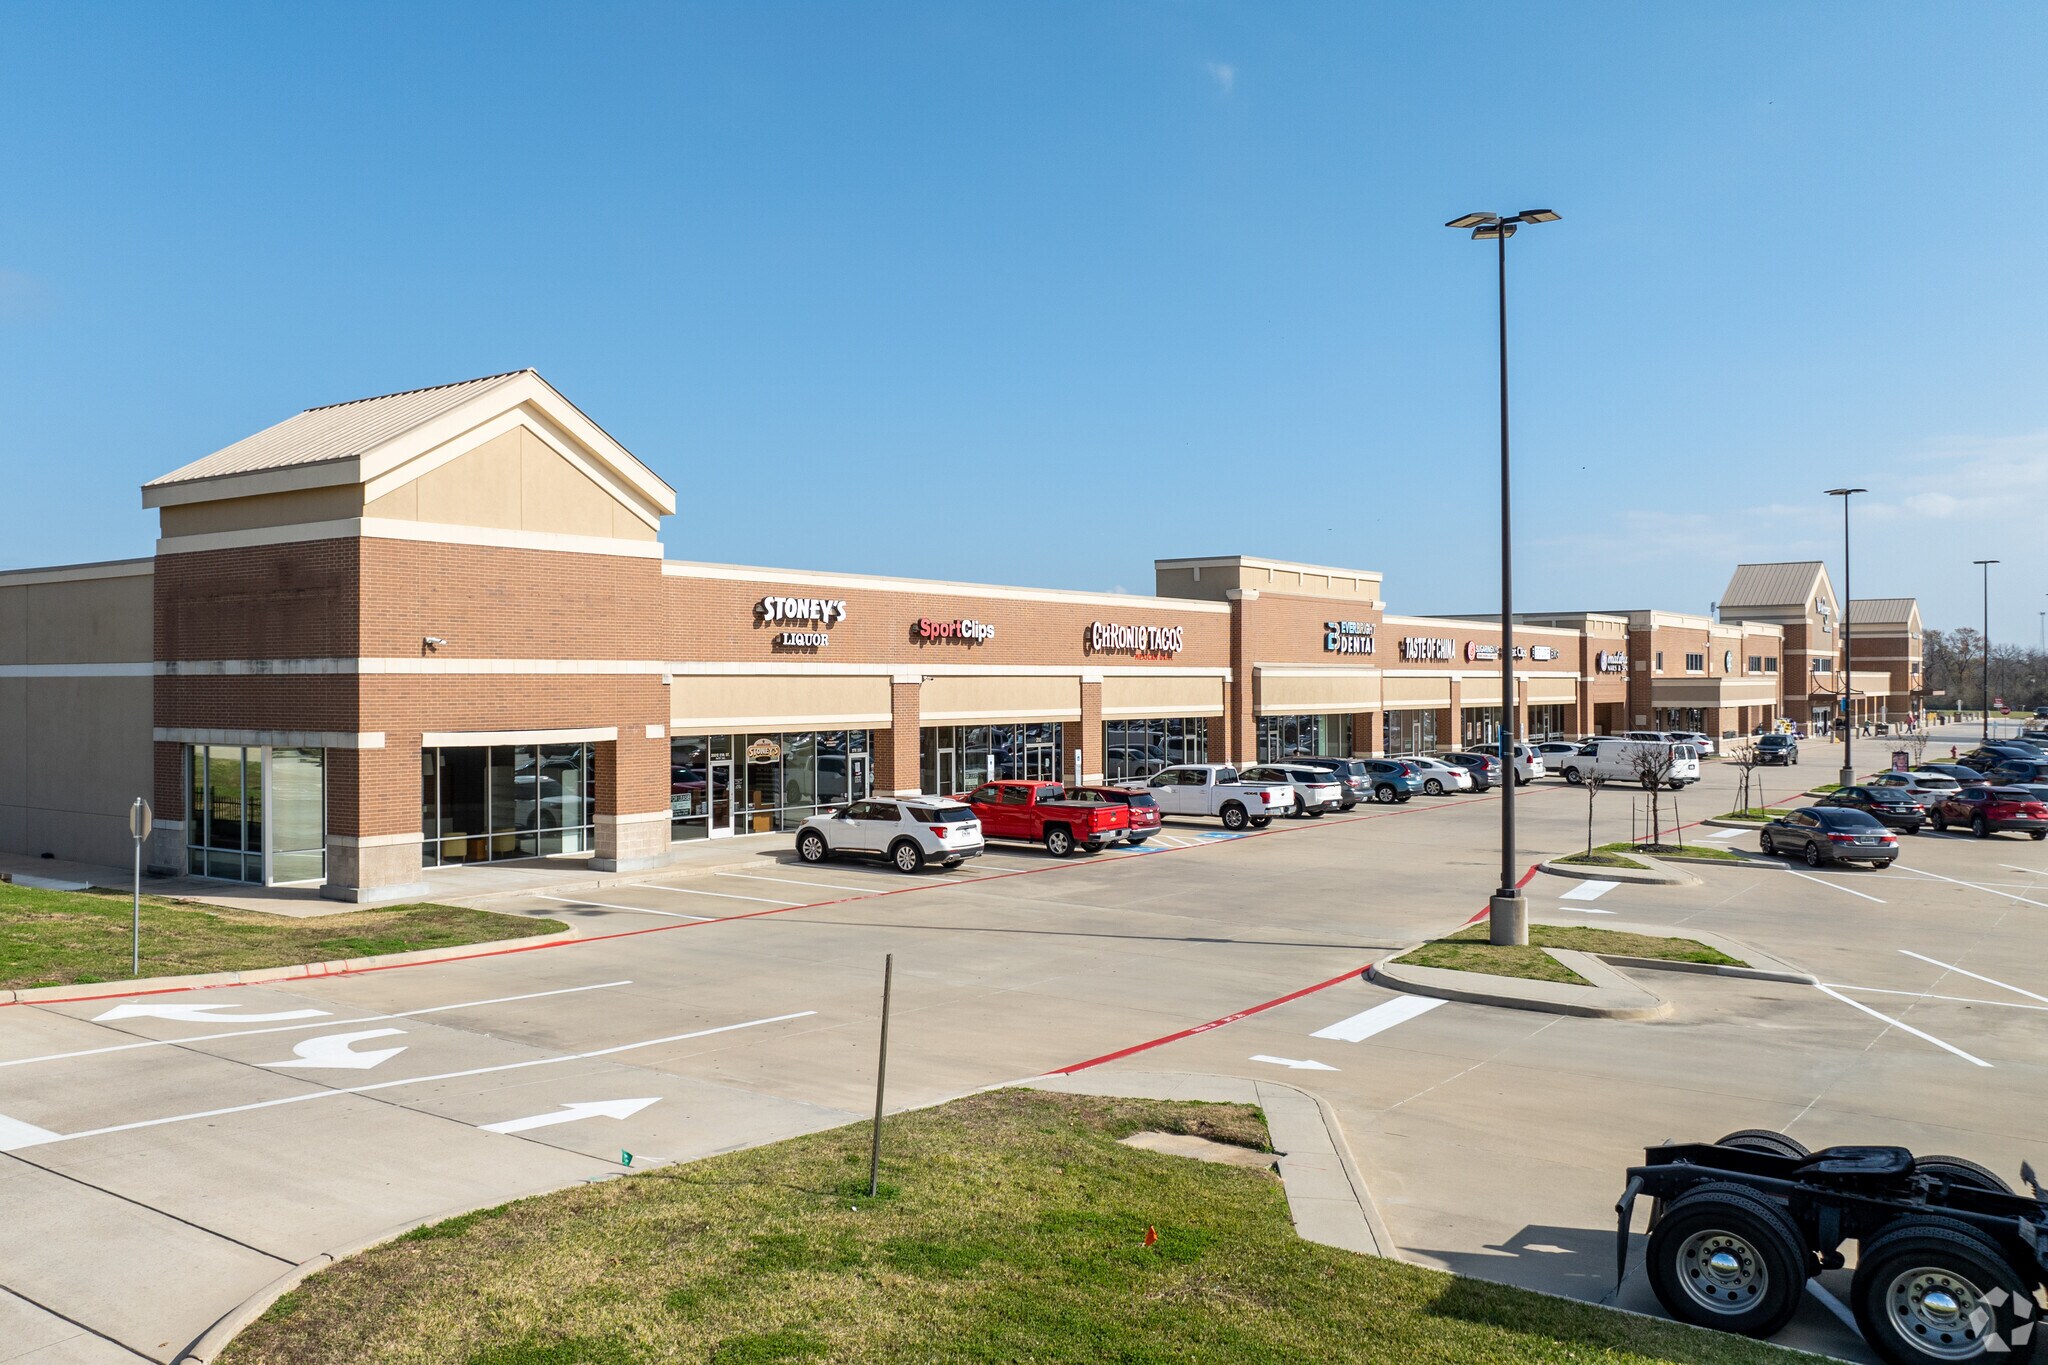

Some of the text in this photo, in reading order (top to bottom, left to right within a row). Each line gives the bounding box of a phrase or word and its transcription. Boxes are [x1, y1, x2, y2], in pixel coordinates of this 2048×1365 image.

[764, 596, 847, 624] STONEY'S
[782, 632, 830, 647] LIQUOR
[1092, 621, 1184, 653] CHRONIC TACOS
[1341, 636, 1376, 653] DENTAL
[1405, 637, 1427, 659] TASTE
[1436, 638, 1456, 659] CHINA
[748, 747, 779, 757] STONEY'S
